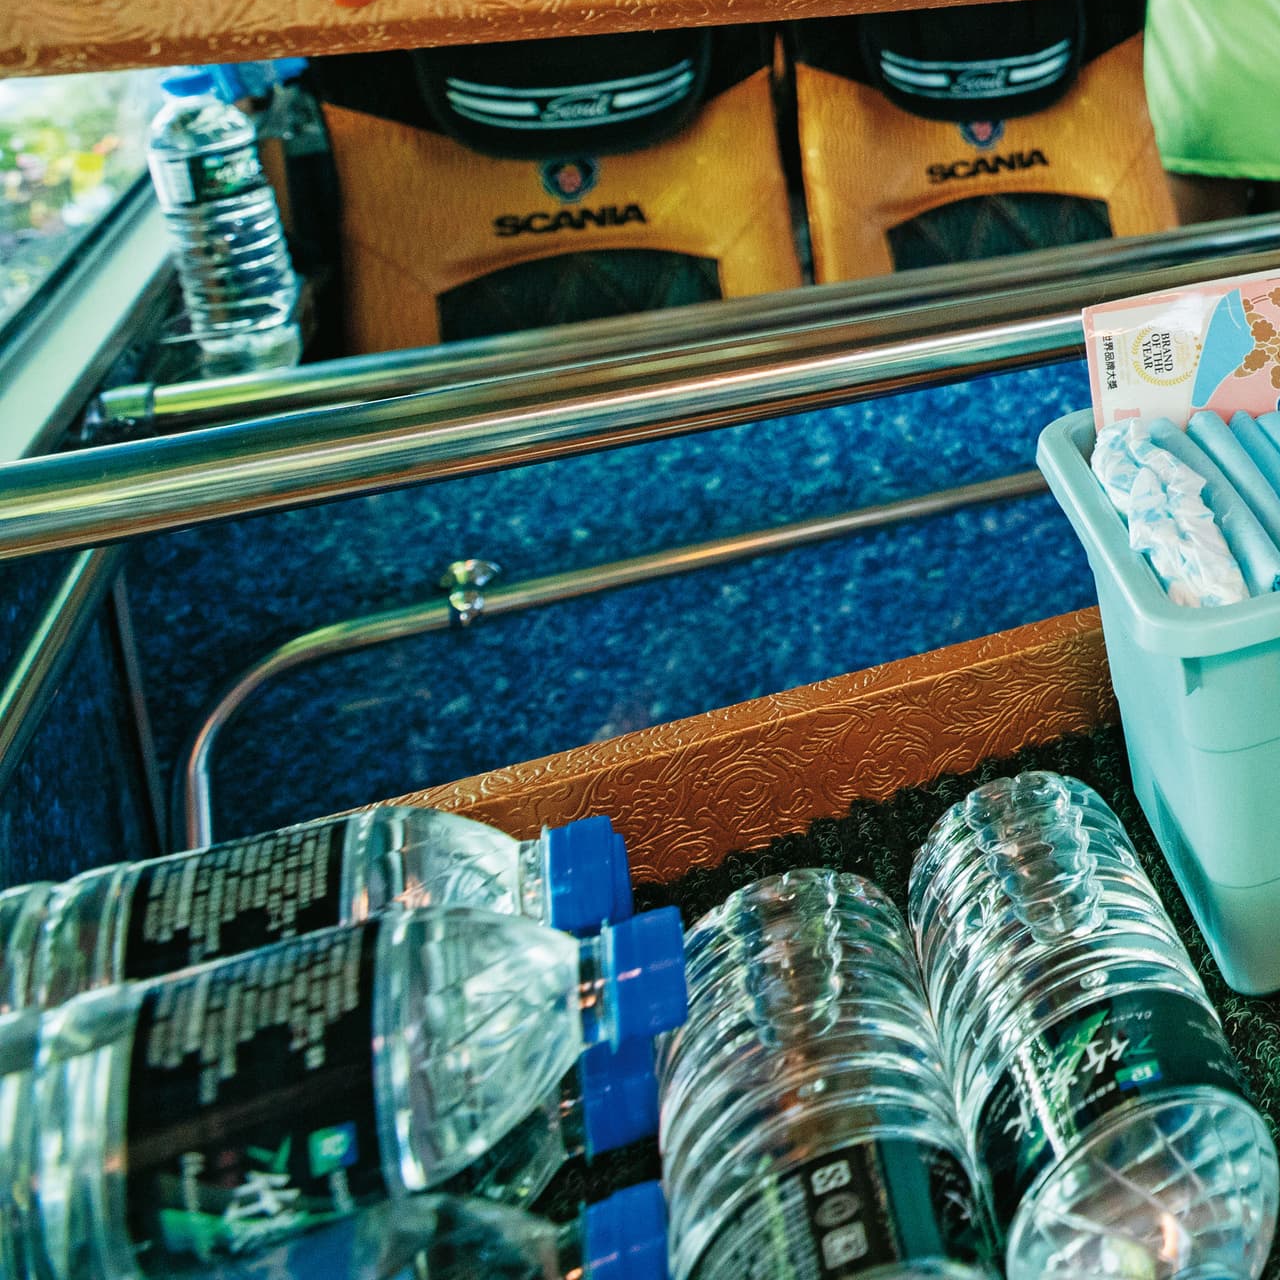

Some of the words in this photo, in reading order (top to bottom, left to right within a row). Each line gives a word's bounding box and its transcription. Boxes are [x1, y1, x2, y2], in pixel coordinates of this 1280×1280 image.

[926, 148, 1049, 185] SCANIA
[492, 203, 648, 238] SCANIA
[1142, 340, 1154, 370] YEAR
[1151, 333, 1161, 349] OF
[1161, 332, 1173, 372] BRAND
[1153, 350, 1164, 375] THE
